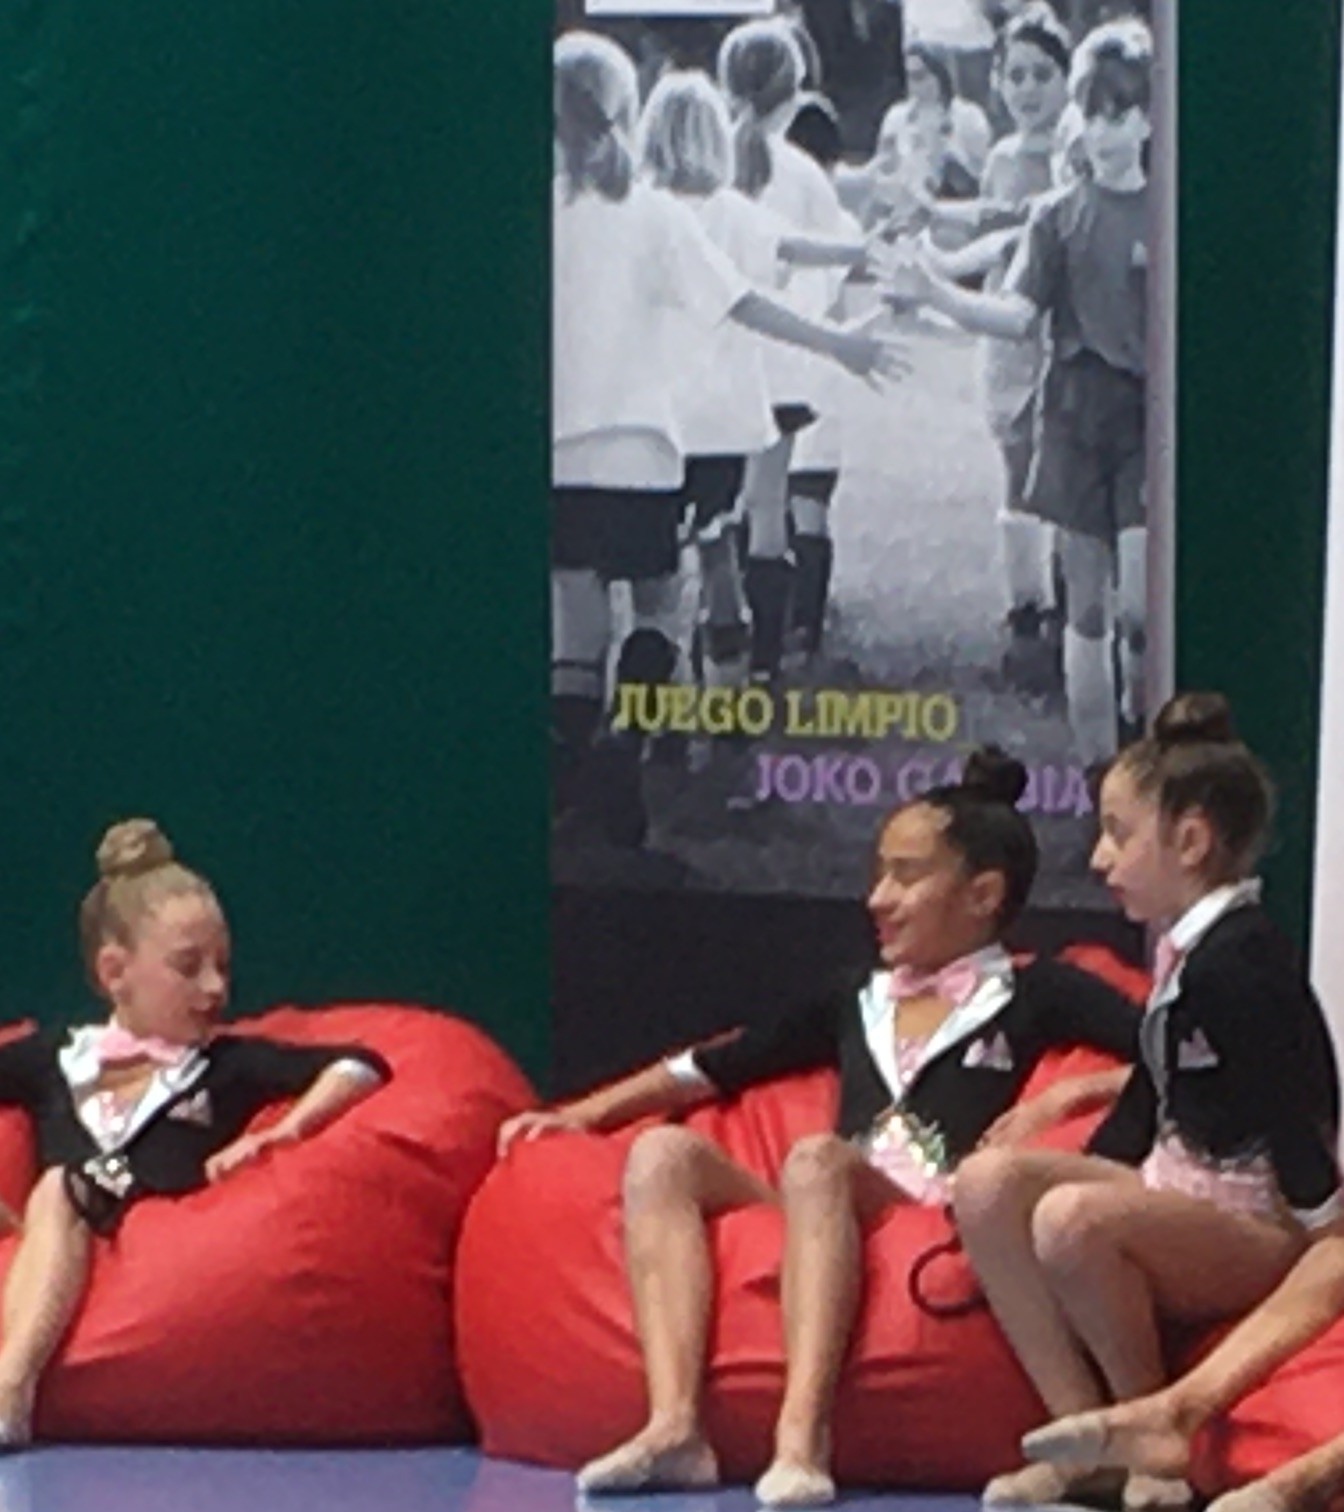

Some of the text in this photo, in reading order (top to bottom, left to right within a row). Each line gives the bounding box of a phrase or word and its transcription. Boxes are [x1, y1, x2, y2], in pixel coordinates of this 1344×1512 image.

[611, 682, 958, 741] JUEGO LIMPIO
[757, 753, 881, 804] JOKO
